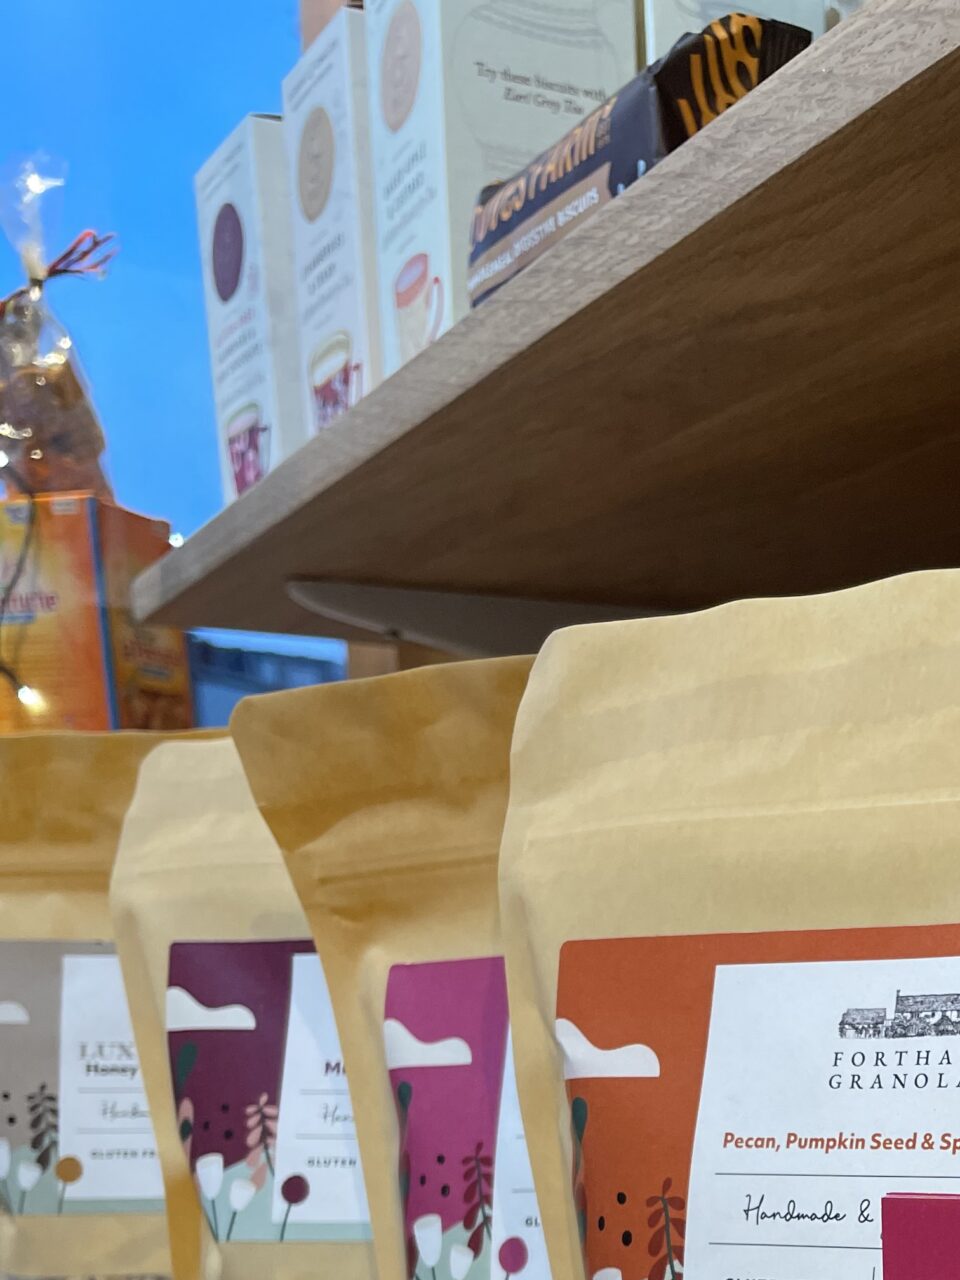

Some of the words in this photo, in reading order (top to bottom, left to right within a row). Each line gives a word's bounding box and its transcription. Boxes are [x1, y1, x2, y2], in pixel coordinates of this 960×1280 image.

[723, 1132, 780, 1152] Pecan,
[786, 1132, 865, 1154] Pumpkin
[870, 1132, 917, 1150] Seed
[921, 1133, 934, 1150] &
[743, 1194, 846, 1225] Handmade
[858, 1199, 873, 1223] &
